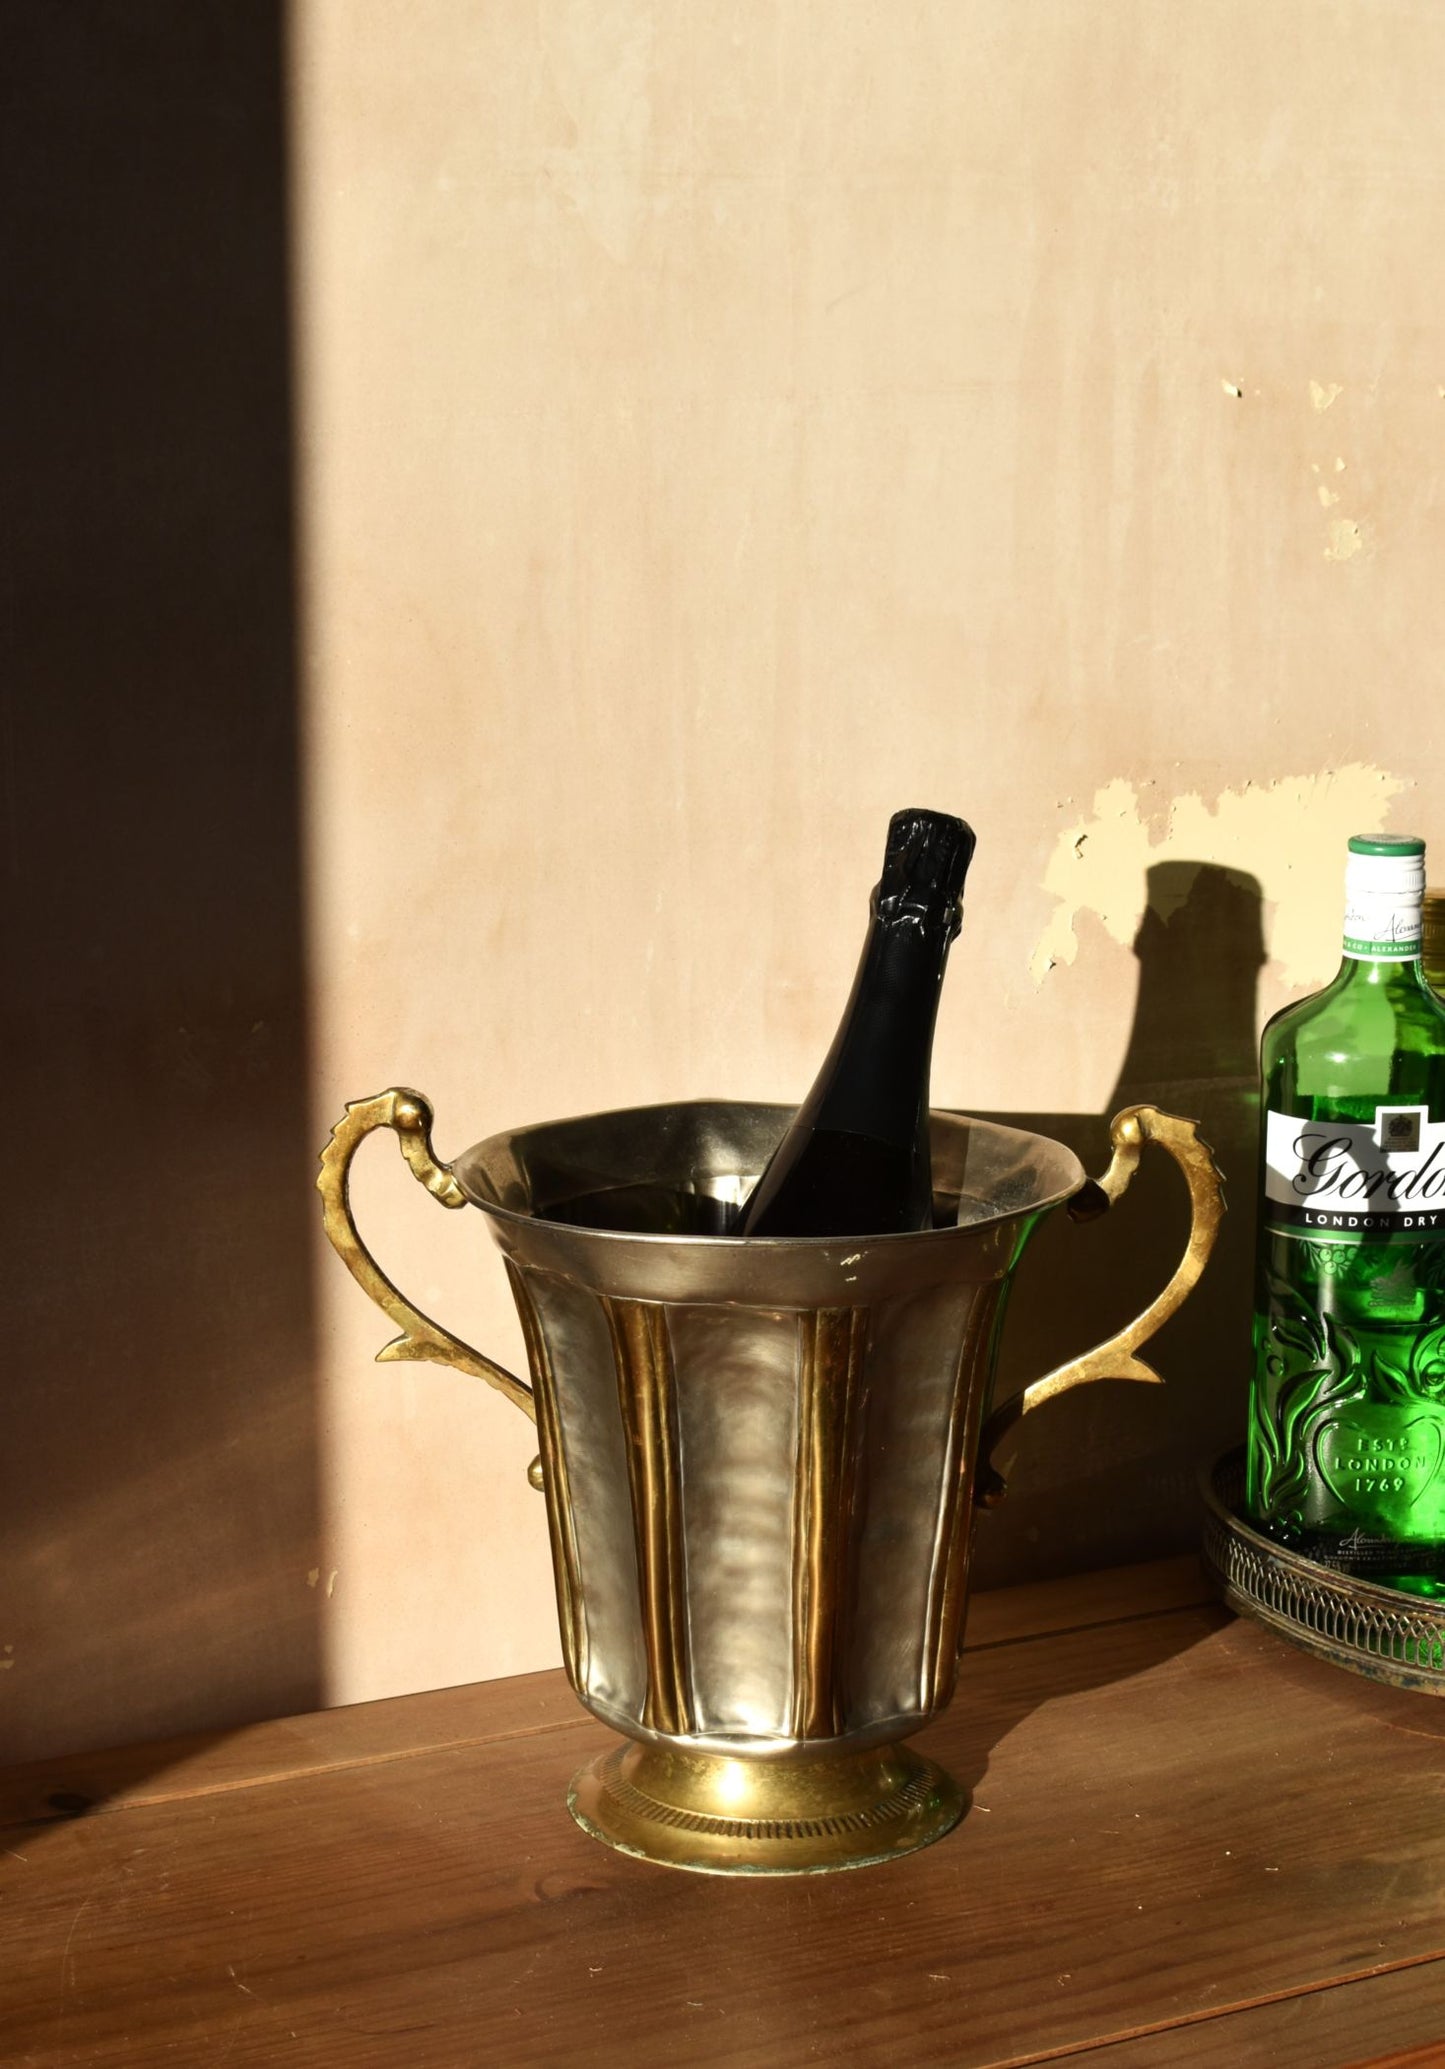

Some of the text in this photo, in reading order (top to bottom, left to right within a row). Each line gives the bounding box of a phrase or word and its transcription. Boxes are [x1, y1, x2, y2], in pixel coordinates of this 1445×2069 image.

[1292, 1133, 1445, 1200] Gordo
[1305, 1213, 1438, 1227] LONDON DRY
[1335, 1456, 1426, 1471] LONDON
[1356, 1477, 1405, 1492] 1769
